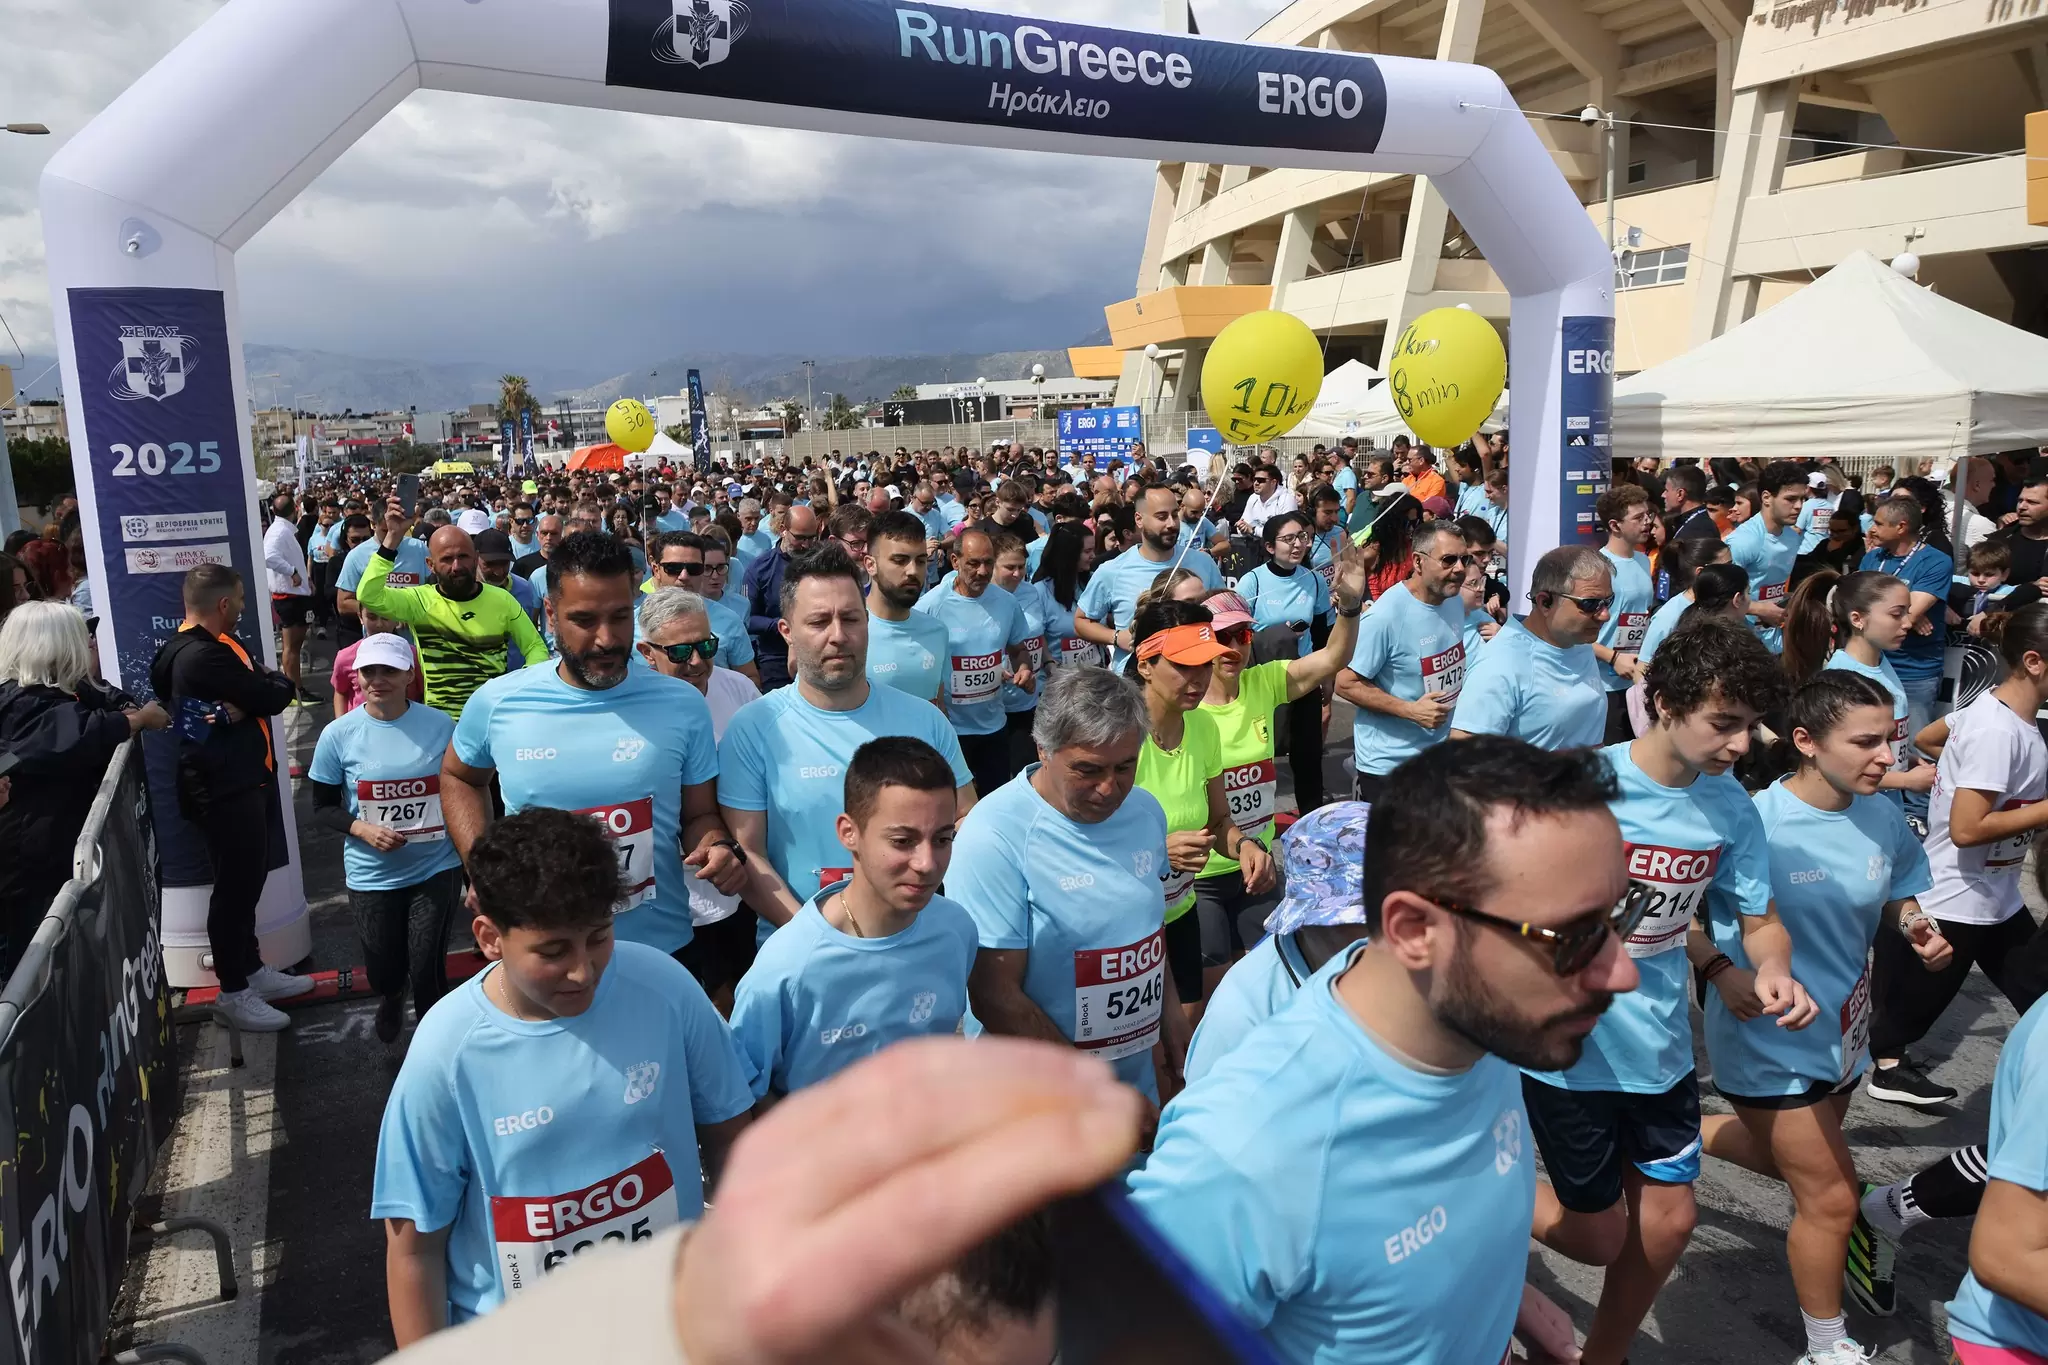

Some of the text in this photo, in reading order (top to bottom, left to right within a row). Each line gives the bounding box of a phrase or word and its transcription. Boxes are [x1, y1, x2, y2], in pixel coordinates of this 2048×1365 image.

[895, 8, 1193, 89] RunGreece
[988, 81, 1111, 118] Ηράκλειο
[1257, 71, 1363, 120] ERGO
[118, 324, 180, 339] ΣΕΓΑΣ
[1567, 349, 1613, 374] ERG
[1077, 416, 1097, 429] ERGO
[109, 441, 222, 477] 2025
[872, 662, 898, 674] ERGO
[960, 655, 996, 670] ERGO
[1431, 647, 1460, 671] ERGO
[964, 670, 995, 687] 5520
[1437, 665, 1463, 691] 7472
[515, 748, 557, 761] ERGO
[800, 764, 838, 779] ERGO
[1224, 765, 1262, 789] RGO
[372, 780, 427, 799] ERGO
[377, 802, 427, 822] 7267
[1227, 790, 1262, 815] 339
[1628, 848, 1710, 880] ERGO
[1789, 867, 1827, 885] ERGO
[1059, 872, 1095, 892] ERGO
[1100, 935, 1162, 981] ERGO
[1106, 972, 1162, 1020] 5246
[1081, 1002, 1089, 1026] Block
[820, 1023, 867, 1045] ERGO
[494, 1105, 554, 1137] ERGO
[524, 1173, 644, 1238] ERGO
[1384, 1204, 1447, 1265] ERGO
[509, 1262, 522, 1290] Block
